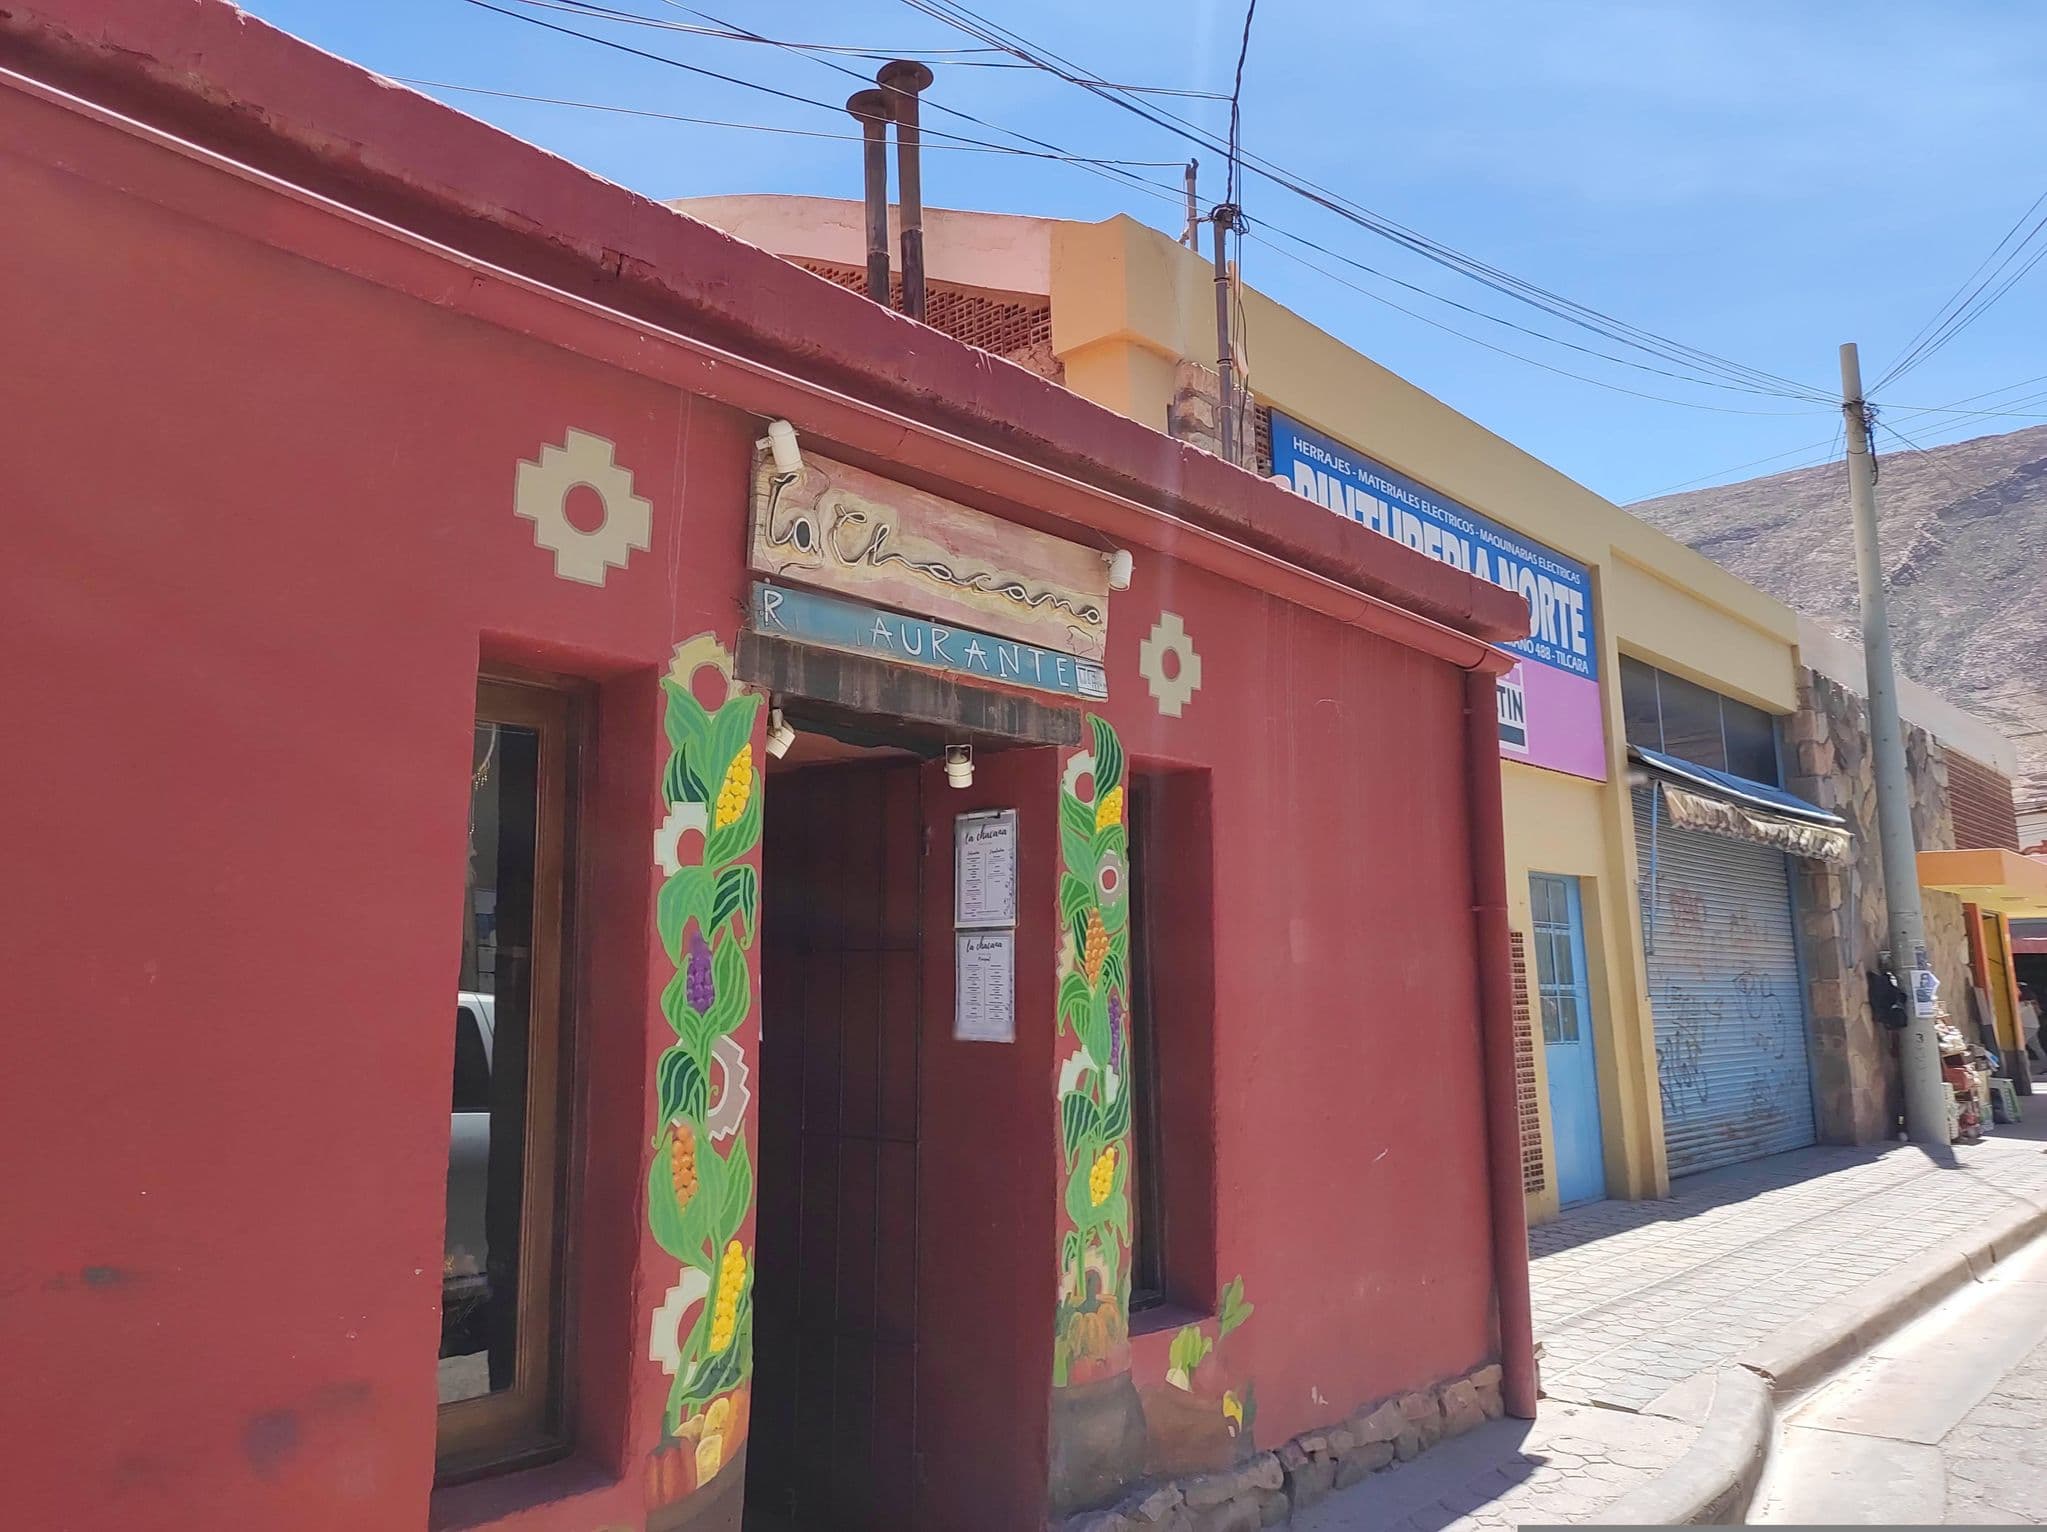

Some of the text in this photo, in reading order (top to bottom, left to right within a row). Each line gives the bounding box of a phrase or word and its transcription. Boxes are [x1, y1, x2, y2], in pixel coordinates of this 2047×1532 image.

[1292, 435, 1351, 476] HERRAJES
[1358, 468, 1420, 509] MATERIALES
[1420, 500, 1475, 536] ELECTRICOS
[1479, 528, 1538, 566] MAQUINARIAS
[1537, 556, 1582, 585] ELECTRICAS
[1554, 649, 1590, 675] TILCARA
